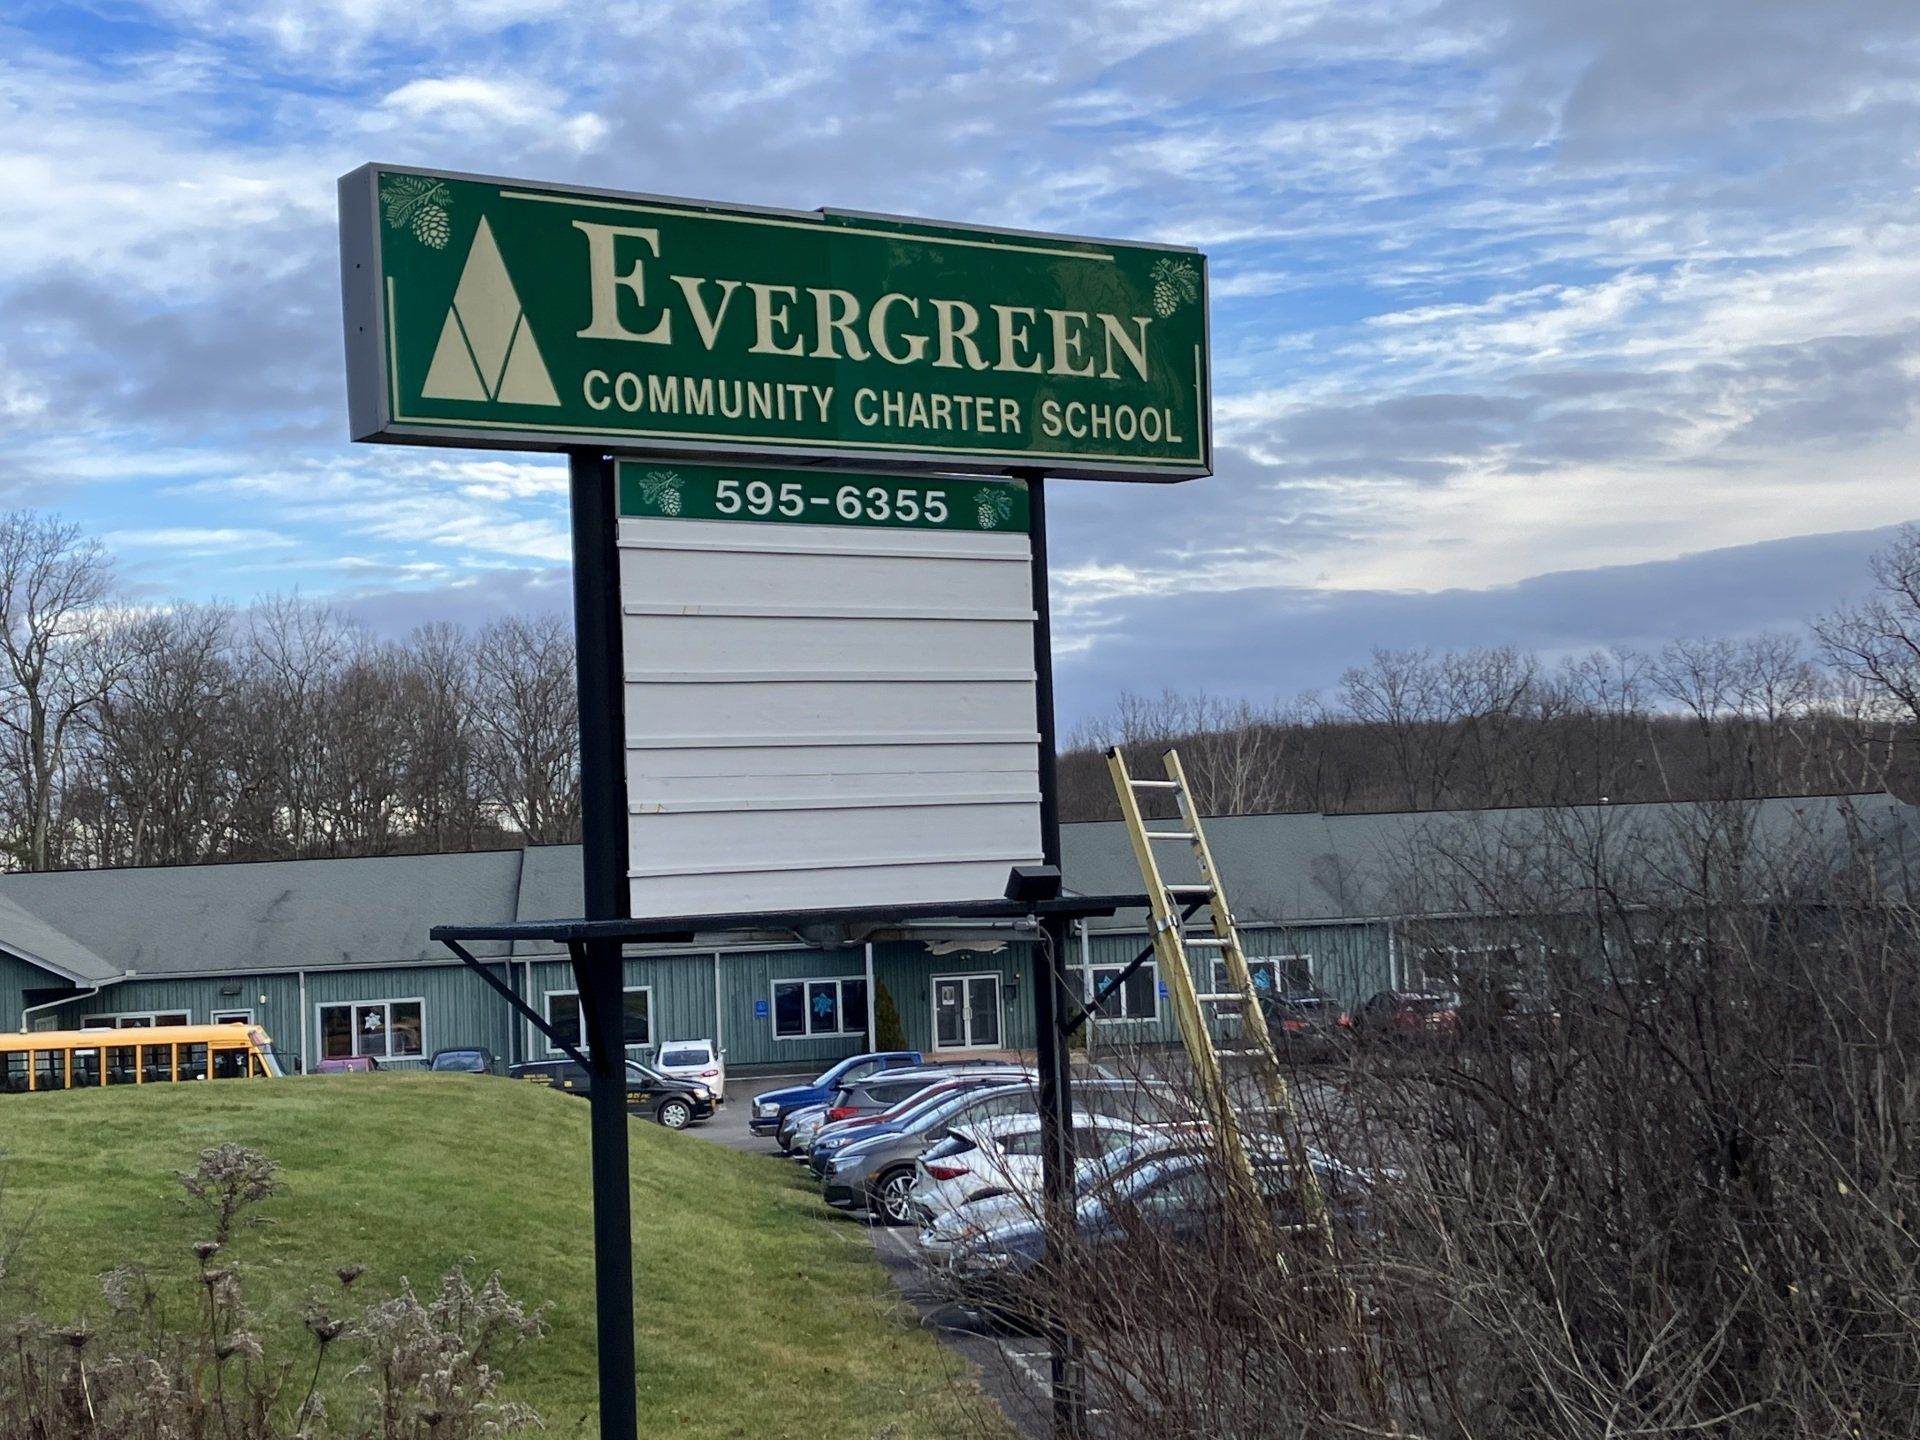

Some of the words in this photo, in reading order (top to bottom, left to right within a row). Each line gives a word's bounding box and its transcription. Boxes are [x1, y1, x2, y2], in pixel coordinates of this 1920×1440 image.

[573, 221, 1152, 381] EVERGREEN
[583, 369, 834, 423] COMMUNITY
[854, 387, 1022, 437] CHARTER
[1041, 399, 1183, 443] SCHOOL
[714, 480, 949, 523] 595-6355
